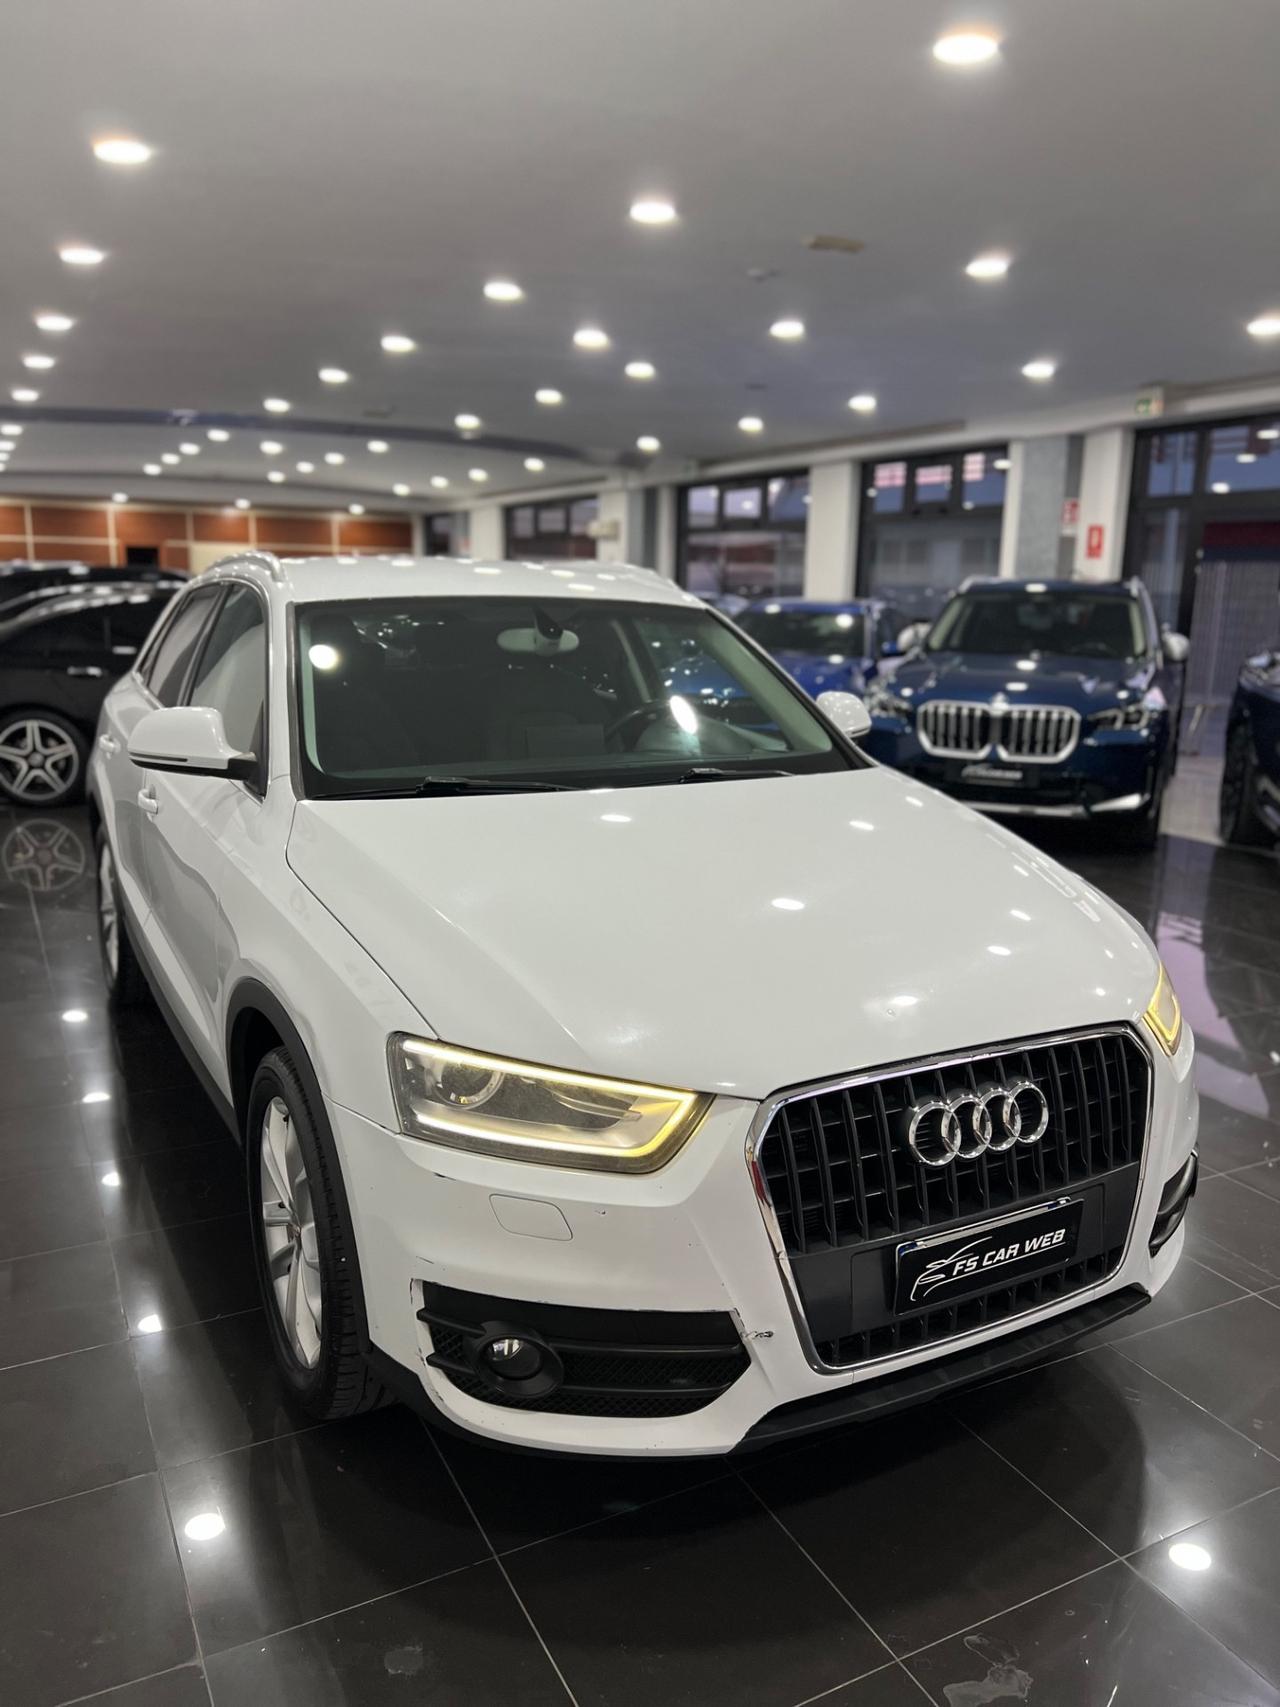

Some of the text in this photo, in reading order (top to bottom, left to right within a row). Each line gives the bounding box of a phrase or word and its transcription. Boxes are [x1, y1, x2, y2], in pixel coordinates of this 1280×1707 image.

[953, 1229, 1066, 1276] FS CAR WEB
